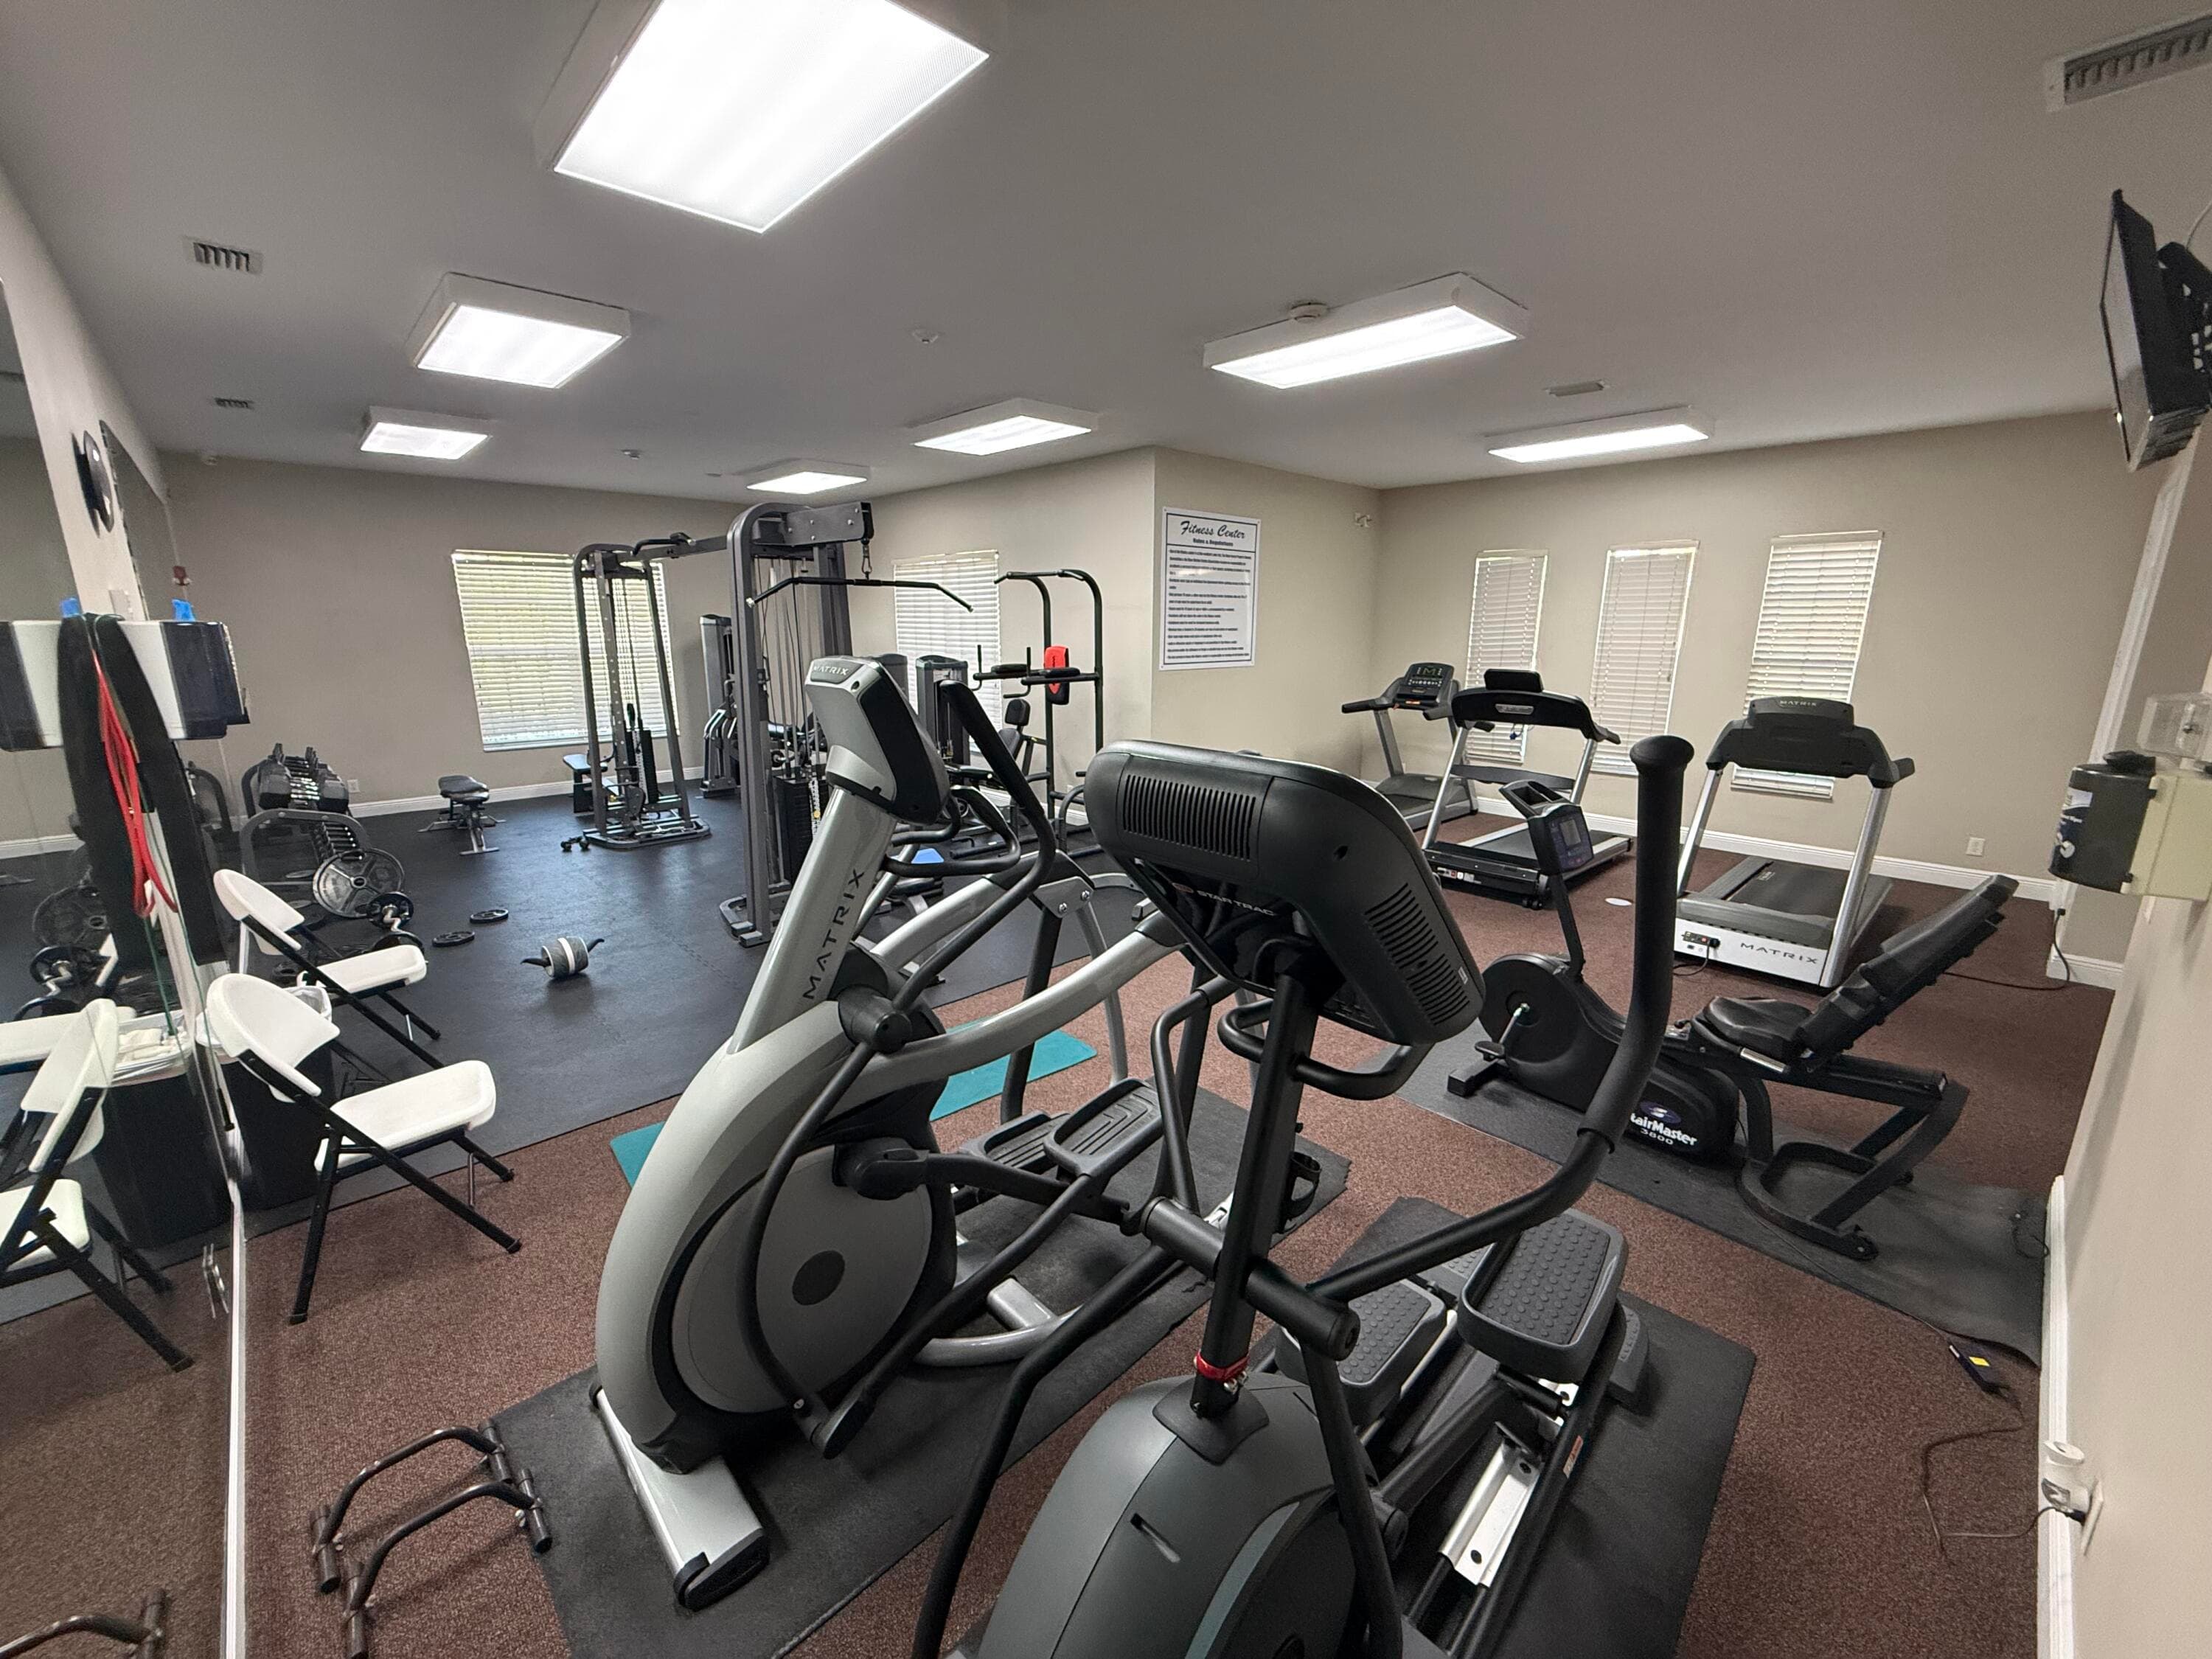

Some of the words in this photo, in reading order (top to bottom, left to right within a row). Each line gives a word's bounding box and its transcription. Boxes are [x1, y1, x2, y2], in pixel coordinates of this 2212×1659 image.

[1180, 521, 1214, 535] Fitness
[1217, 525, 1245, 539] Center
[813, 666, 849, 676] MATRIX
[802, 869, 865, 999] MATRIX
[1740, 942, 1818, 964] MATRIX
[1630, 1113, 1697, 1146] tairMaster
